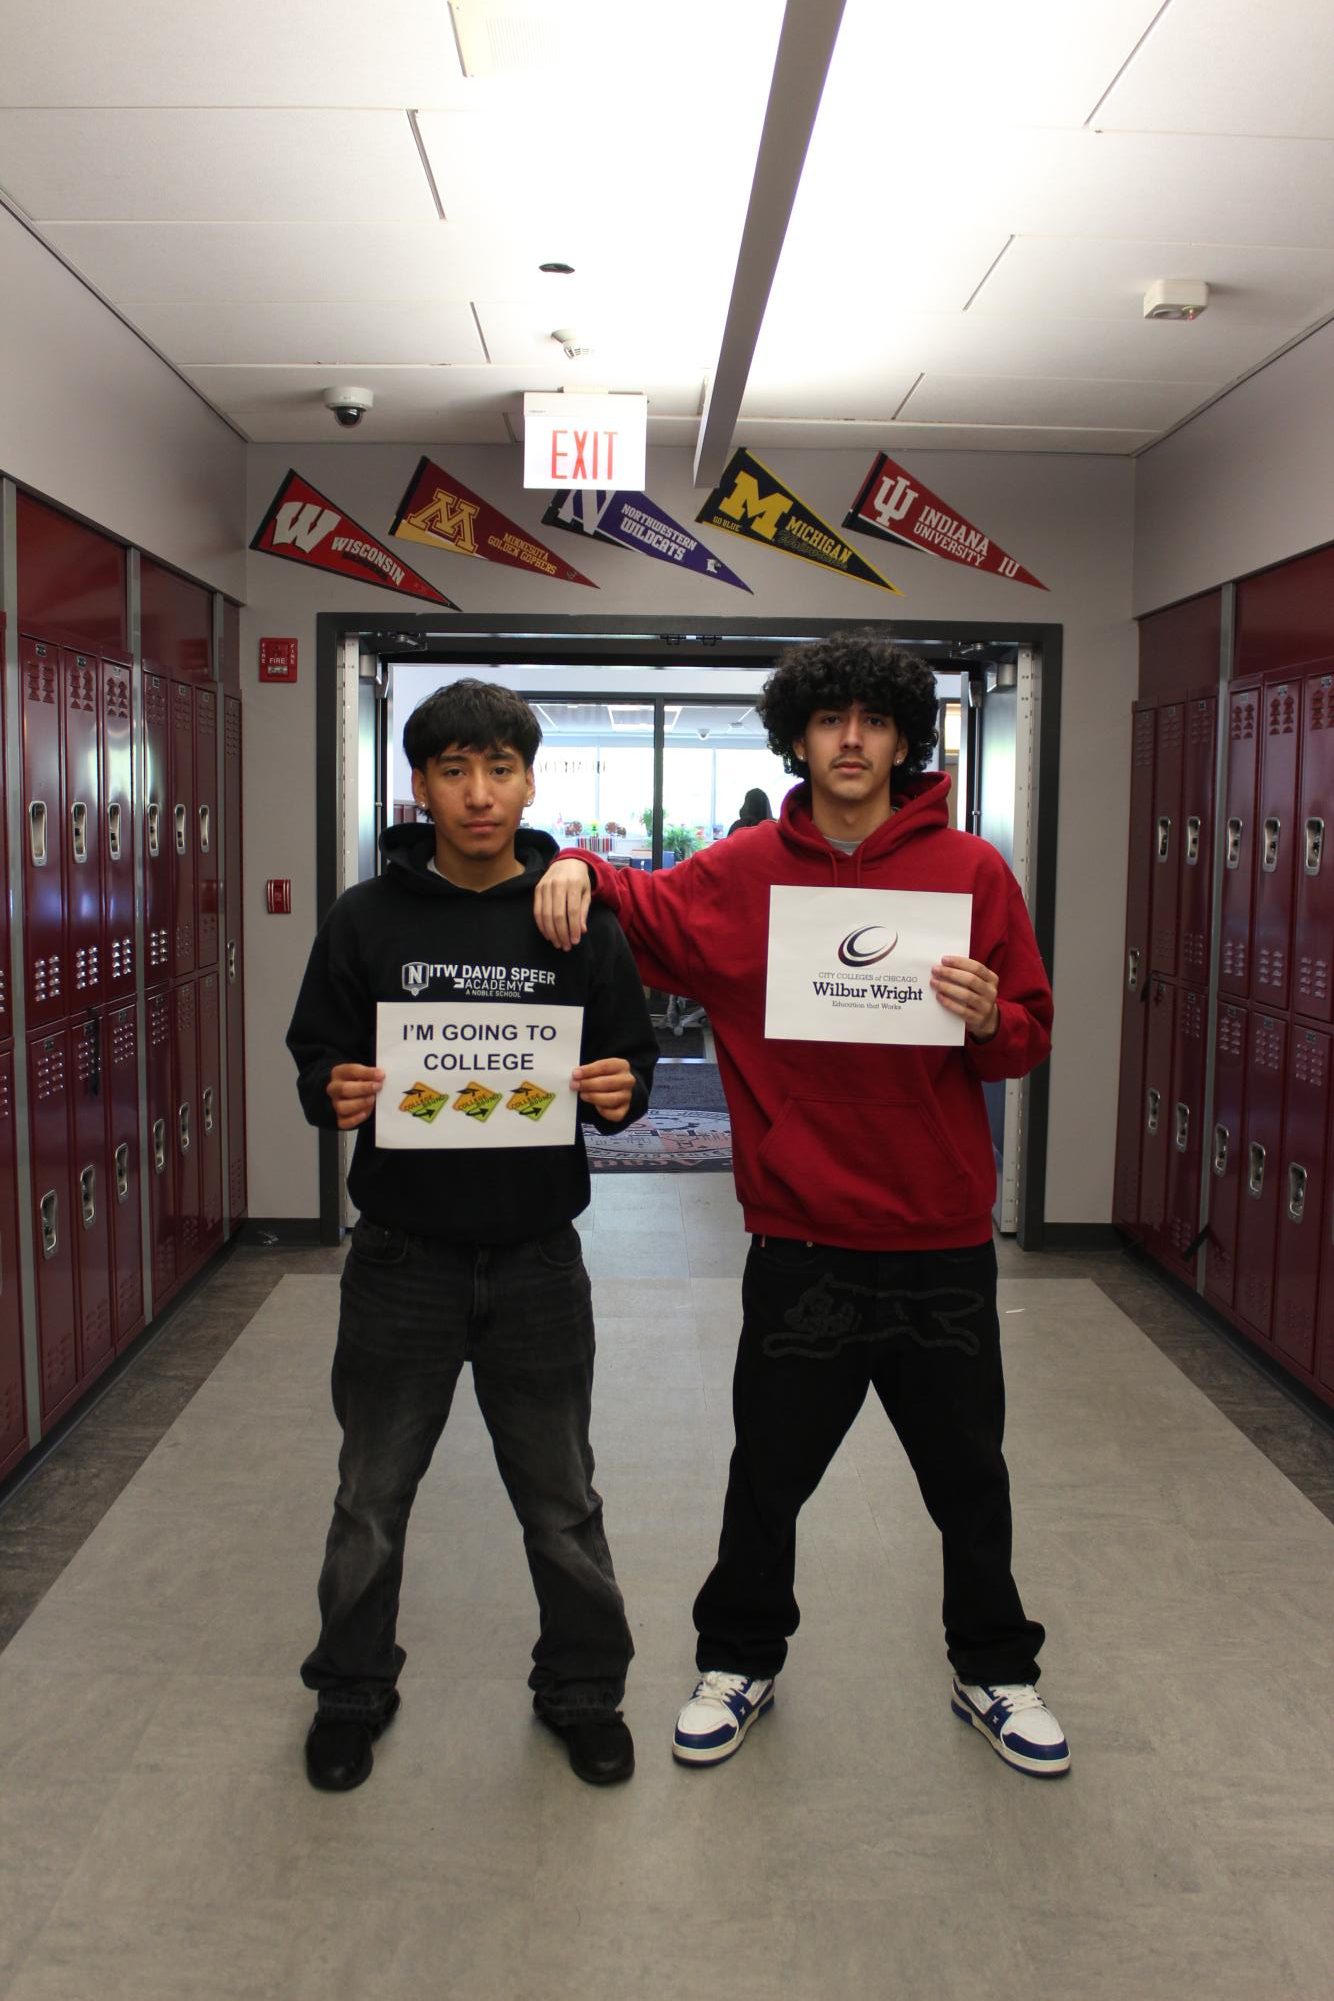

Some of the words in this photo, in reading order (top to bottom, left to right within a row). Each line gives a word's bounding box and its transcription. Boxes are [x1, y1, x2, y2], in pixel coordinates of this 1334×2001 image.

[551, 430, 618, 480] EXIT
[718, 470, 793, 541] M
[272, 501, 342, 554] W
[407, 488, 480, 554] M
[621, 504, 699, 551] NORTHWESTERN
[713, 515, 723, 526] GO
[722, 519, 742, 532] BLUE
[918, 506, 990, 556] INDIANA
[504, 532, 549, 561] MINNESOTA
[619, 516, 687, 562] WILDCATS
[785, 516, 853, 564] MICHIGAN
[913, 521, 986, 567] UNIVERSITY
[331, 536, 406, 586] WISCONSIN
[488, 534, 519, 562] GOLDEN
[520, 551, 558, 575] GOPHERS
[998, 557, 1020, 578] IU
[408, 965, 423, 984] N
[430, 964, 458, 977] ITW
[462, 965, 507, 980] DAVID
[511, 967, 556, 986] SPEER
[465, 978, 524, 992] ACADEMY
[837, 973, 874, 981] COLLEGES
[883, 975, 918, 983] CHICAGO
[495, 991, 521, 999] SCHOOL
[813, 981, 867, 998] Wilbur
[870, 984, 923, 1003] Wright
[832, 1000, 865, 1009] Education
[403, 1024, 434, 1041] I'M
[442, 1024, 518, 1041] GOING
[526, 1025, 557, 1041] TO
[424, 1053, 534, 1071] COLLEGE
